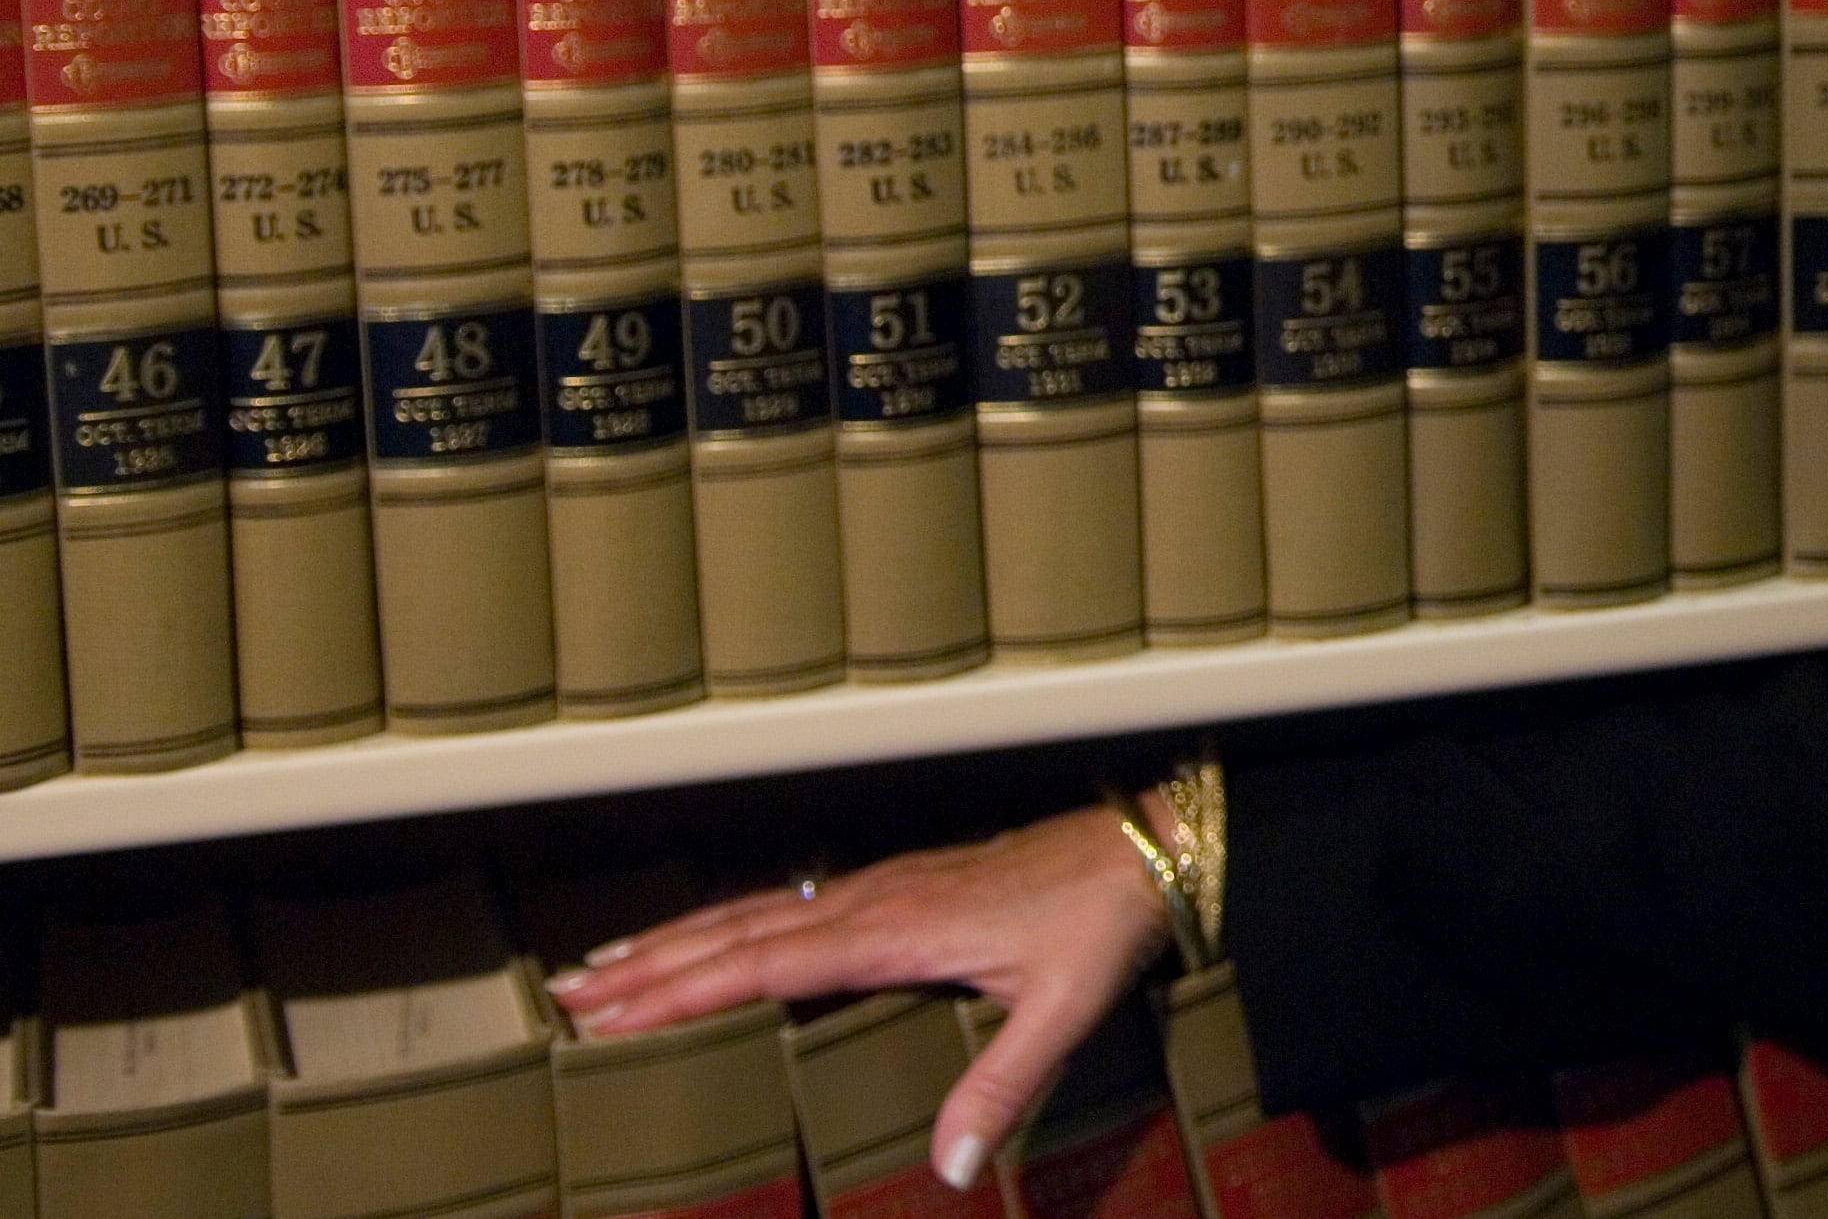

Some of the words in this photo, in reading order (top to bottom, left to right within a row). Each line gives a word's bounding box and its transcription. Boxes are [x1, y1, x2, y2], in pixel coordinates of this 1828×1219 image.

[1442, 247, 1499, 303] 55
[1576, 243, 1640, 295] 56
[1701, 225, 1755, 280] 57
[1016, 275, 1085, 332] 52
[1156, 267, 1223, 324] 53
[1302, 259, 1364, 315] 54
[578, 312, 650, 370] 49
[731, 295, 799, 356] 50
[869, 291, 937, 350] 51
[99, 341, 178, 403] 46
[250, 332, 330, 391] 47
[415, 325, 492, 382] 48
